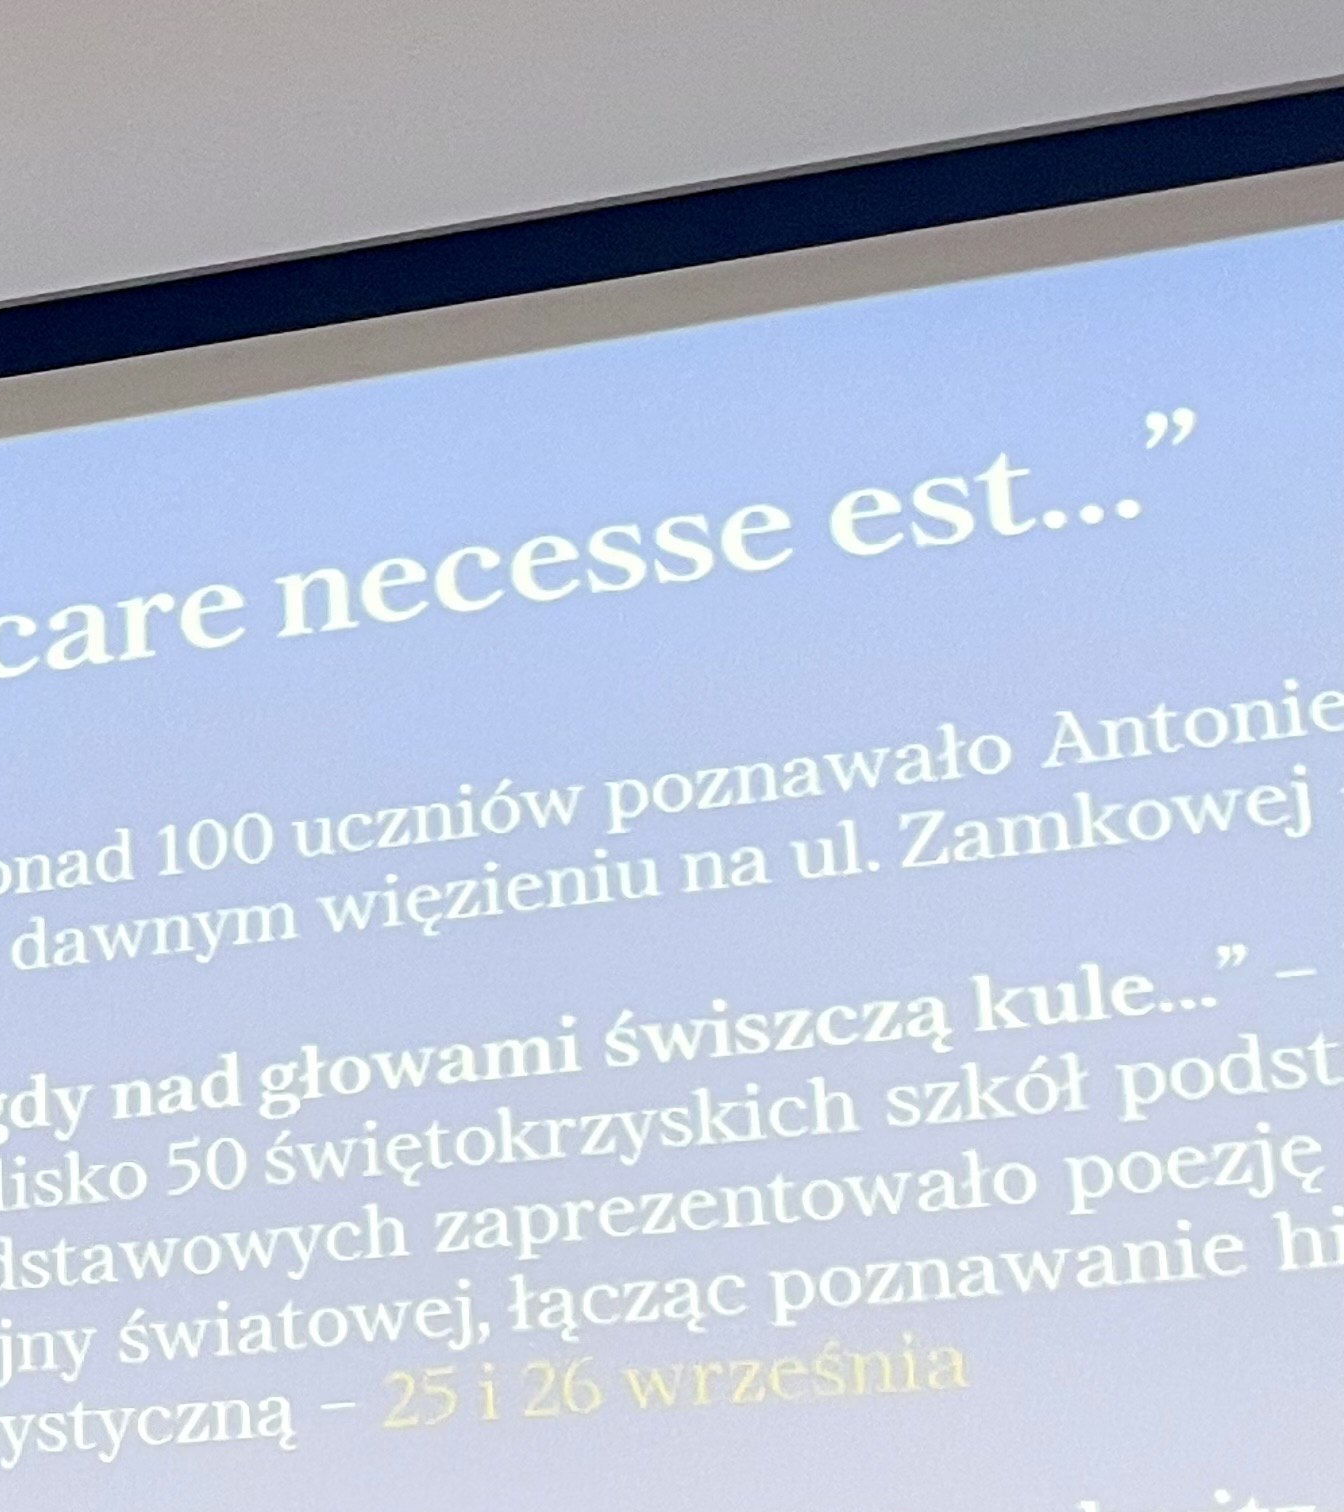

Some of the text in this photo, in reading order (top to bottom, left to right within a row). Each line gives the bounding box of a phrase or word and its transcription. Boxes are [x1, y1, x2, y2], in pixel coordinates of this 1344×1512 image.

[274, 503, 793, 638] necesse
[11, 902, 298, 970] dawnym
[317, 848, 661, 937] więzieniu
[683, 846, 771, 893] na
[791, 818, 880, 879] ul.
[900, 763, 1312, 868] Zamkowej
[159, 812, 274, 876] 100
[291, 778, 585, 859] uczniów
[605, 721, 1013, 835] poznawało
[110, 1051, 242, 1120] nad
[258, 1014, 582, 1120] głowami
[605, 996, 953, 1067] świszczą
[167, 1136, 248, 1196] 50
[265, 1076, 860, 1187] świętokrzyskich
[886, 1051, 1088, 1127] szkół
[1115, 1033, 1344, 1122] podst
[435, 1148, 1038, 1261] zaprezentowało
[1064, 1135, 1325, 1215] poezję
[118, 1278, 490, 1363] światowej,
[508, 1273, 747, 1342] łącząc
[768, 1219, 1248, 1327] poznawanie
[382, 1365, 458, 1429] 25
[479, 1362, 500, 1421] i
[523, 1355, 604, 1417] 26
[622, 1331, 970, 1409] września
